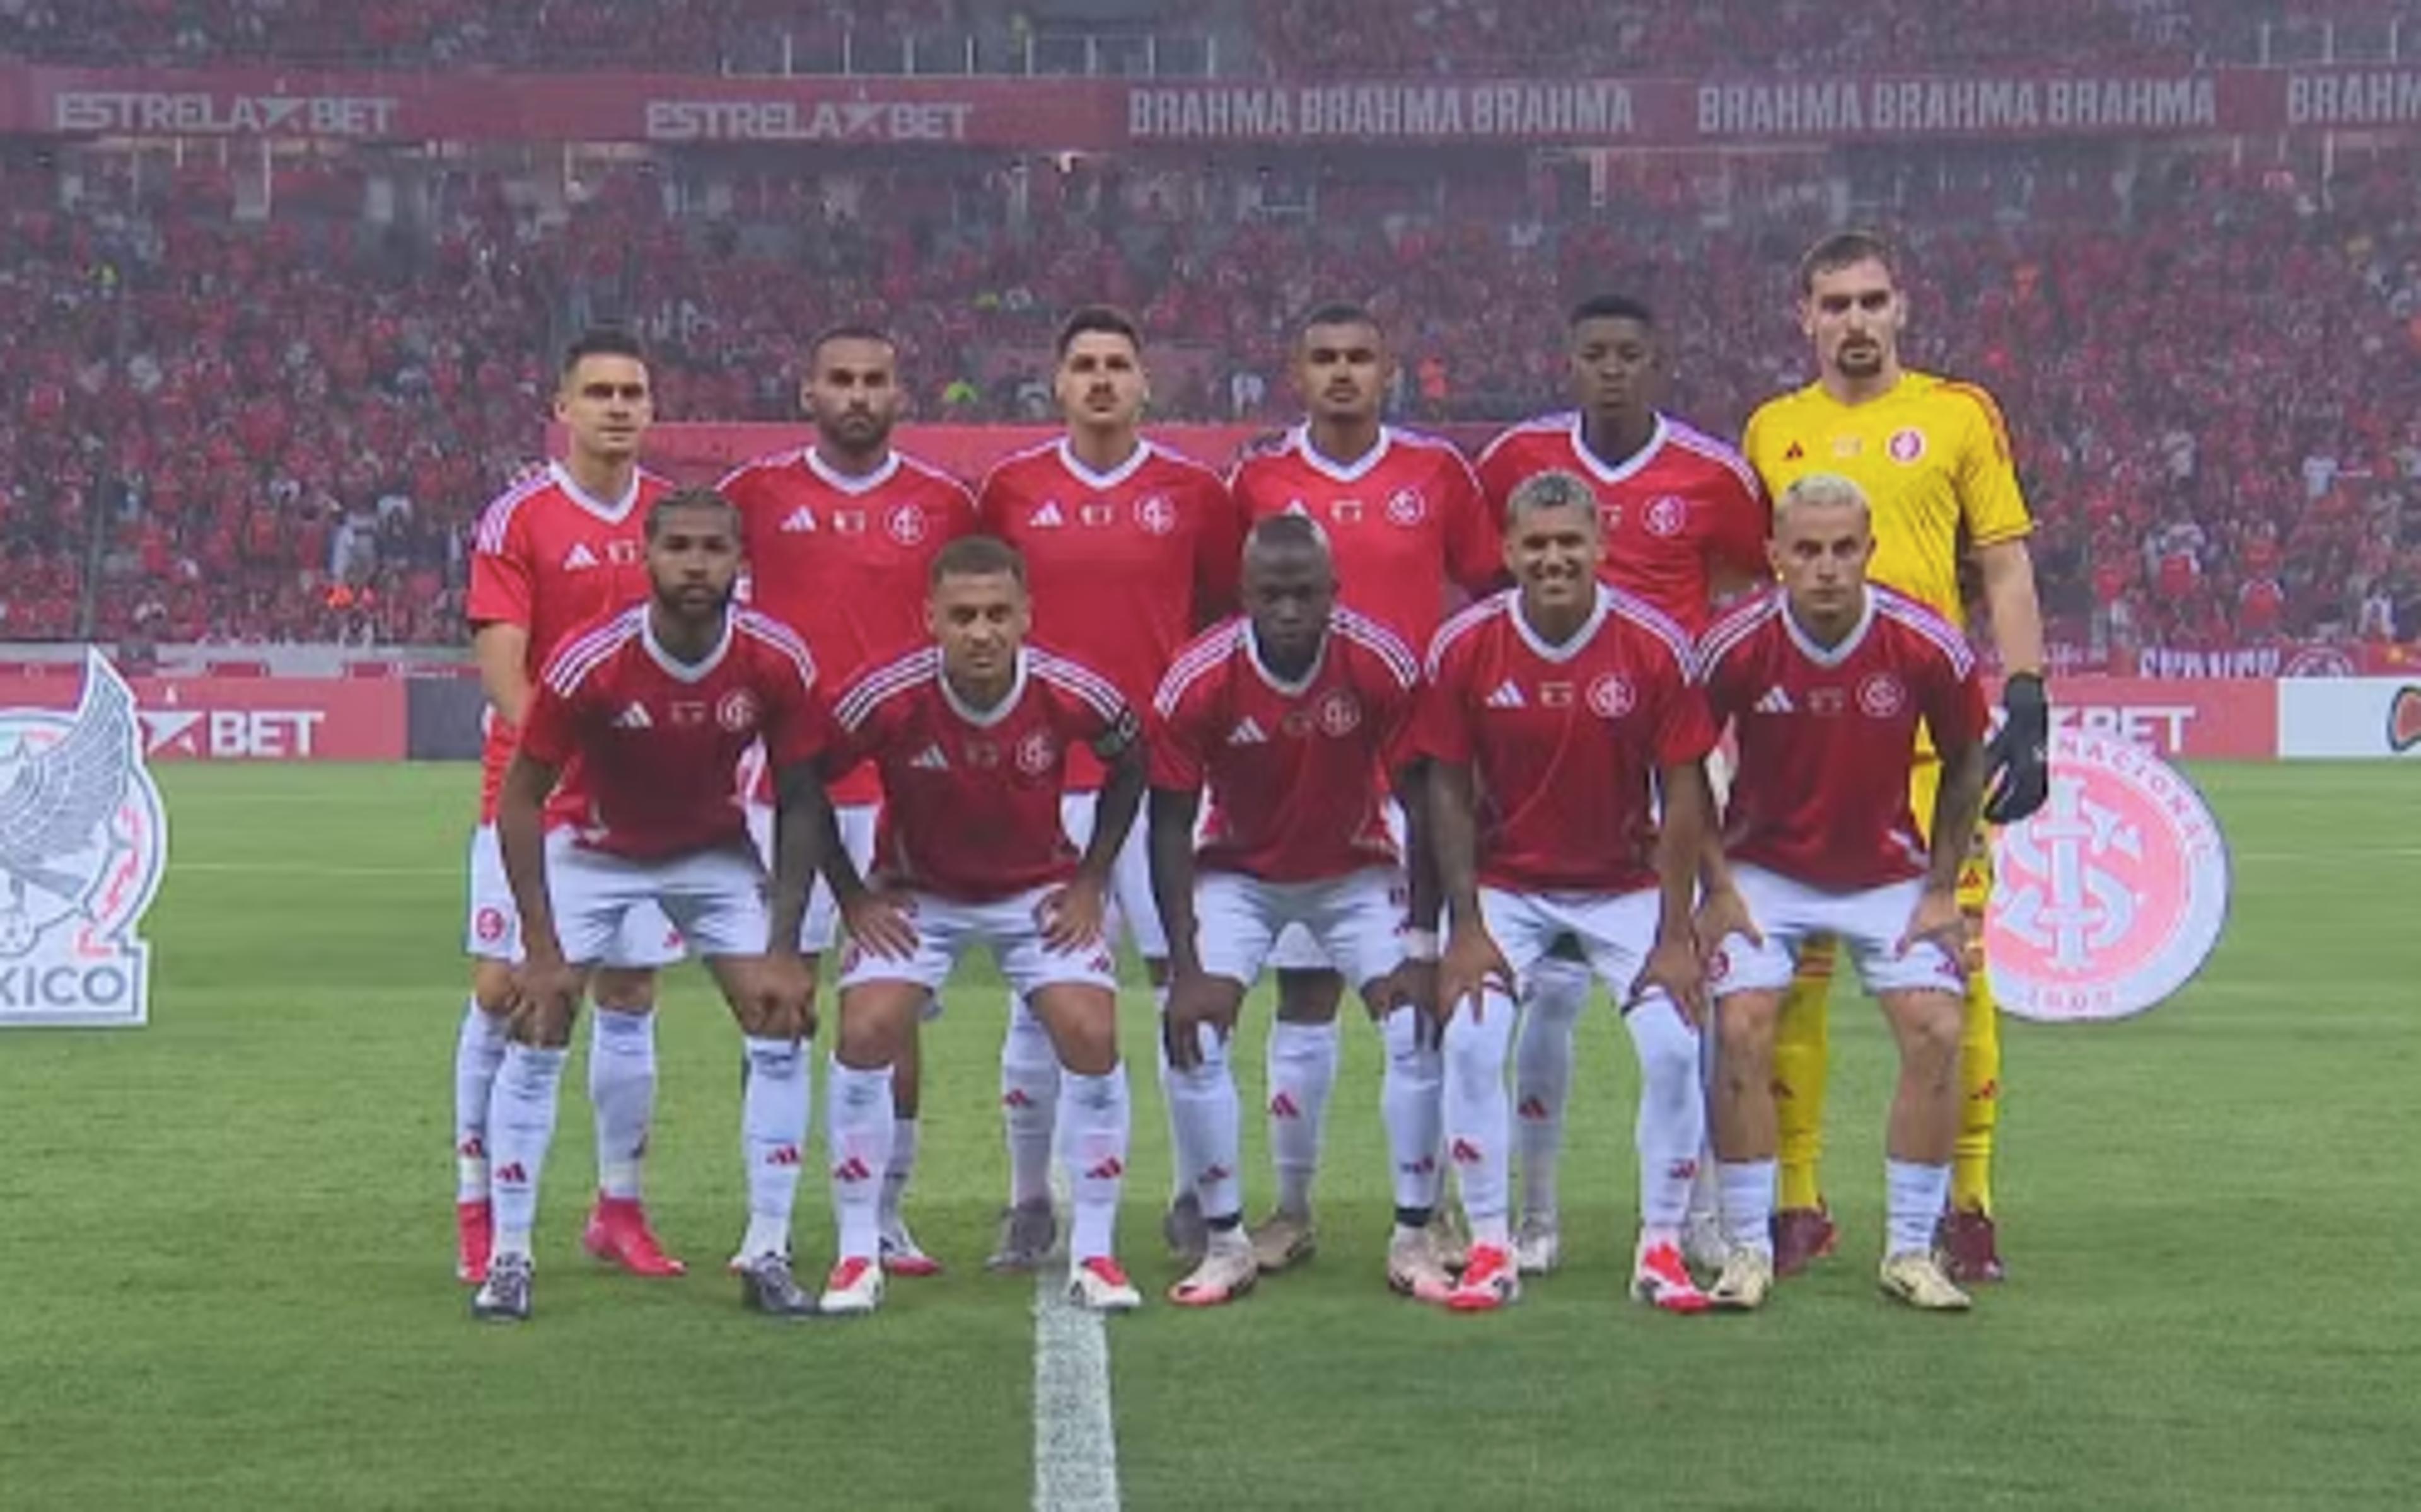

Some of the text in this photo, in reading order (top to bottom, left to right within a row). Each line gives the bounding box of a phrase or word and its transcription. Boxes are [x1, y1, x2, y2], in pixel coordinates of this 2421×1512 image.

[310, 95, 397, 132] BET
[890, 101, 972, 139] BET
[1129, 82, 1633, 135] BRAHMA BRAHMA BRAHMA
[1698, 77, 2215, 132] BRAHMA BRAHMA BRAHMA
[209, 711, 325, 756] BET
